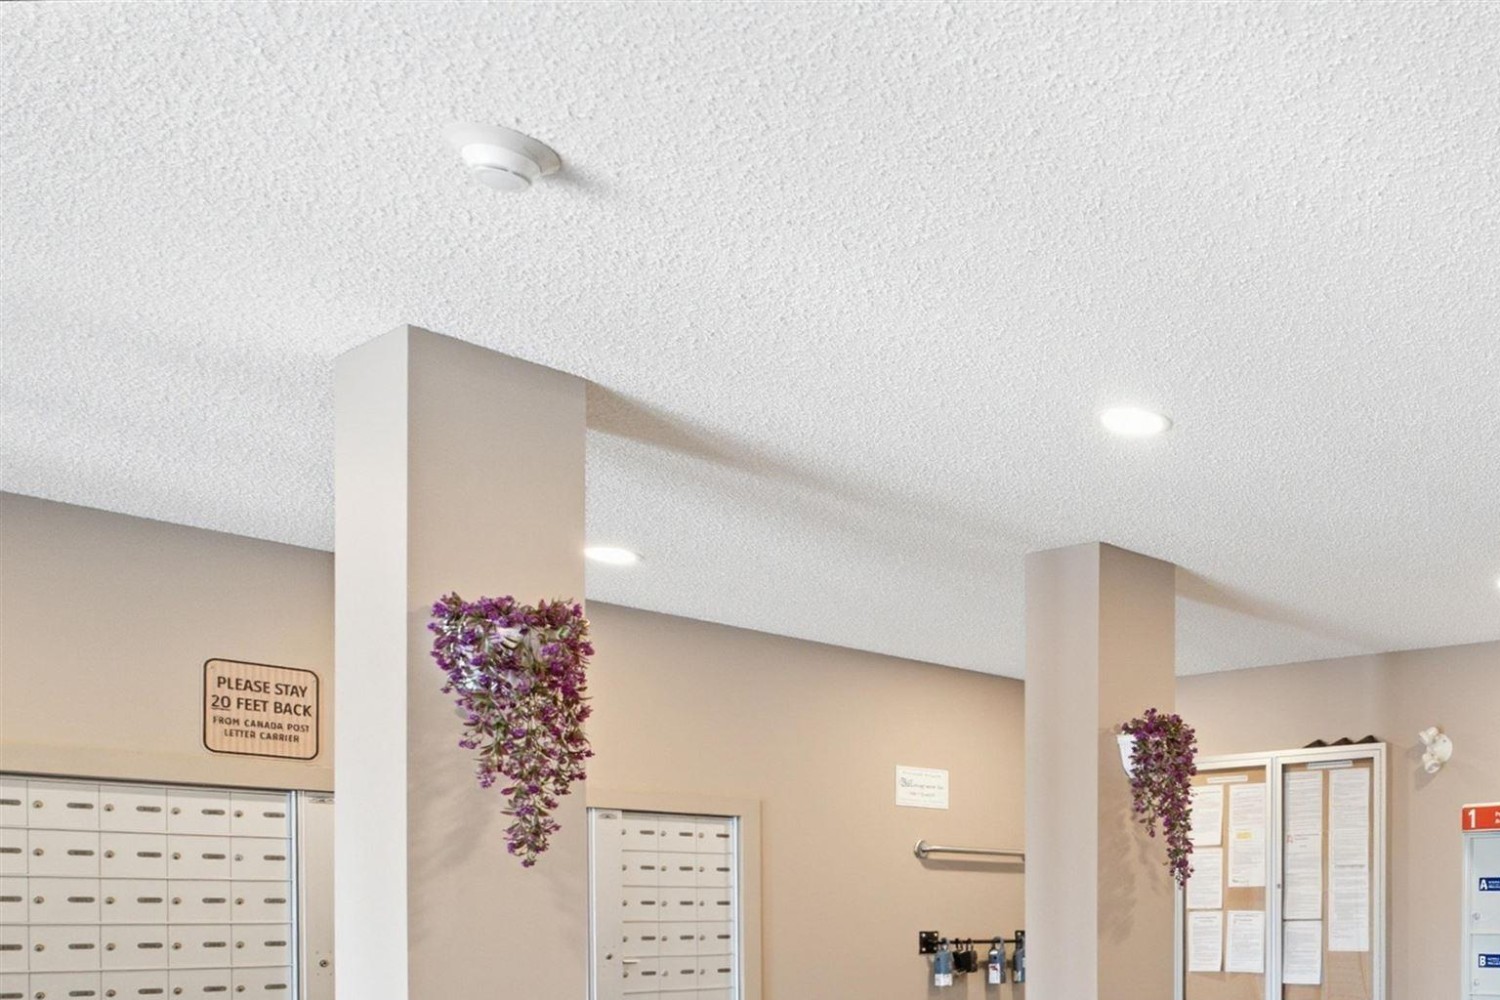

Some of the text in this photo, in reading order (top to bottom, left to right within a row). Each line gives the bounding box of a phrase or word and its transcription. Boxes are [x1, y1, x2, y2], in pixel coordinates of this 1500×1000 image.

[217, 676, 308, 698] PLEASE STAY
[211, 694, 312, 717] 20 FEET BACK
[212, 716, 310, 733] FROM CANADA POST
[224, 729, 300, 742] LETTER CARRIER
[1468, 808, 1476, 828] 1
[1480, 879, 1488, 890] A
[1479, 955, 1486, 966] B
